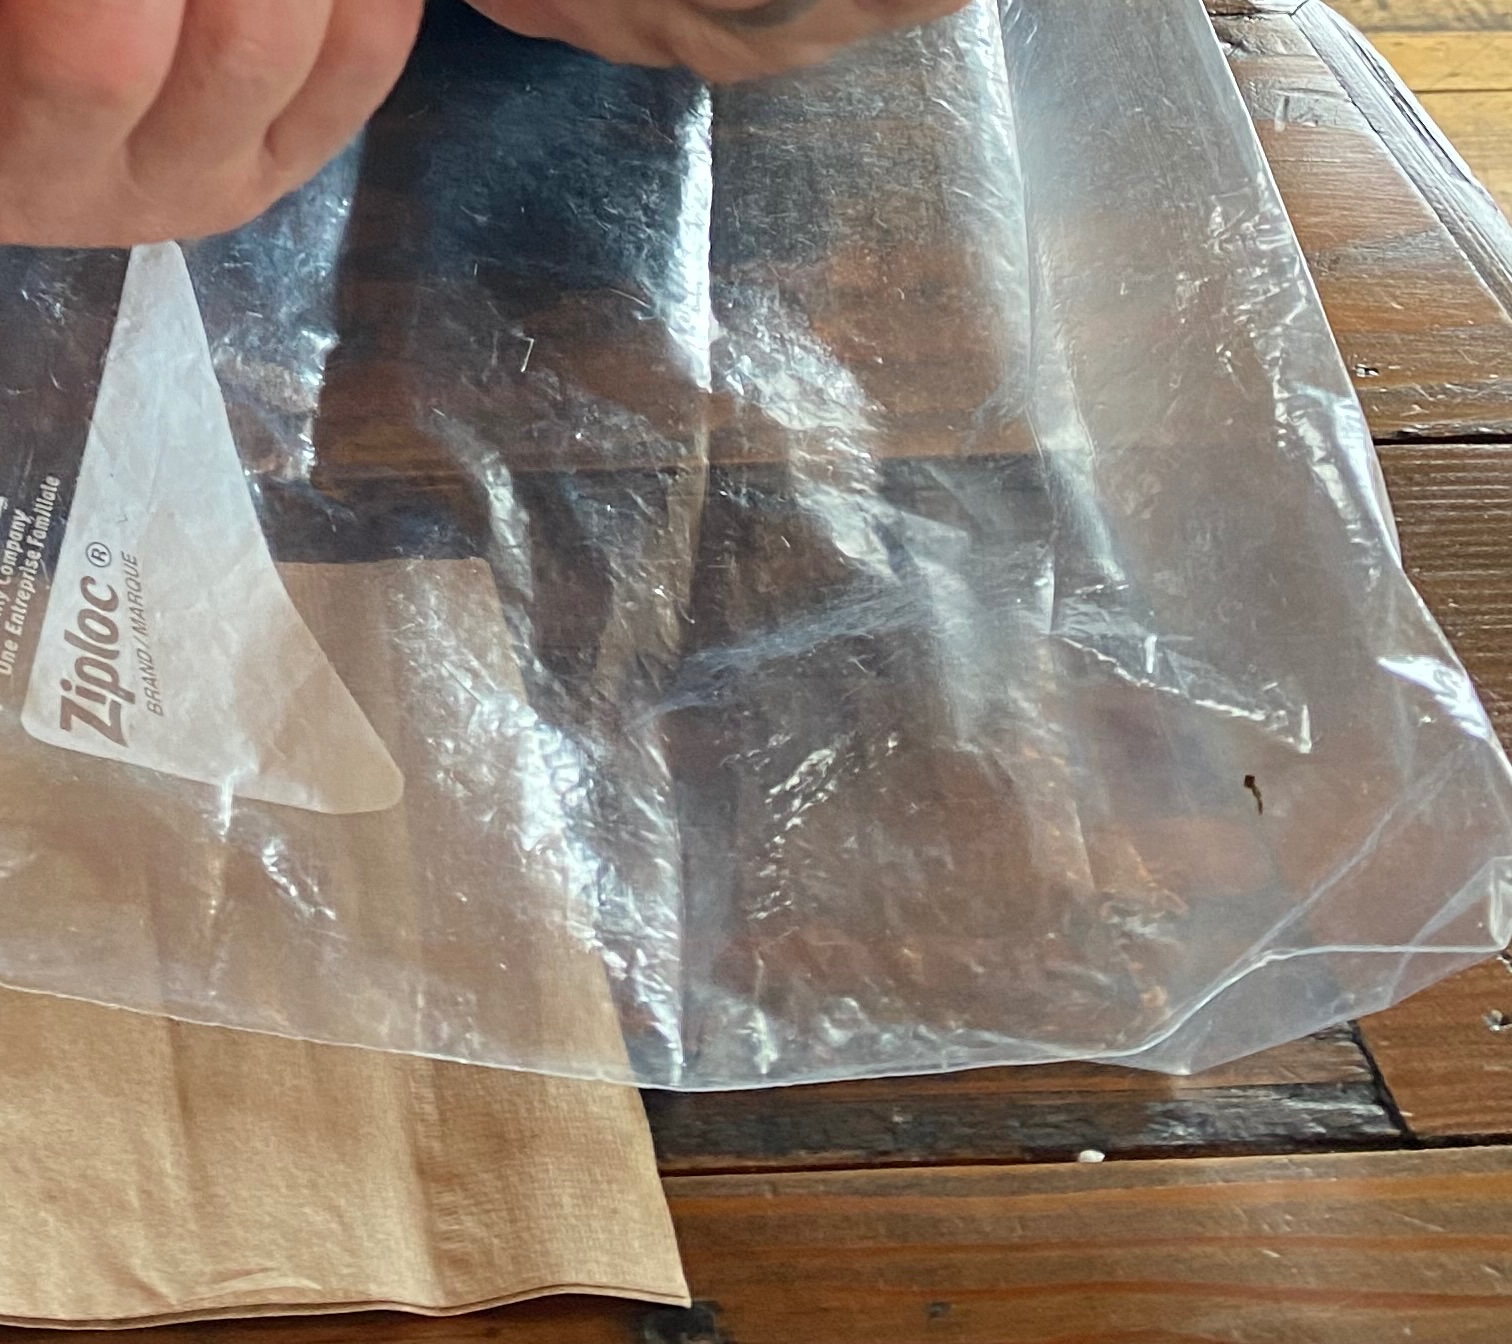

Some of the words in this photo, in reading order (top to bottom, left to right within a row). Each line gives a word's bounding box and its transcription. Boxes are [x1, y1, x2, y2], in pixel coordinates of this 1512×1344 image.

[4, 547, 42, 638] Entreprise
[26, 475, 61, 549] Familiale
[59, 575, 136, 748] Ziploc
